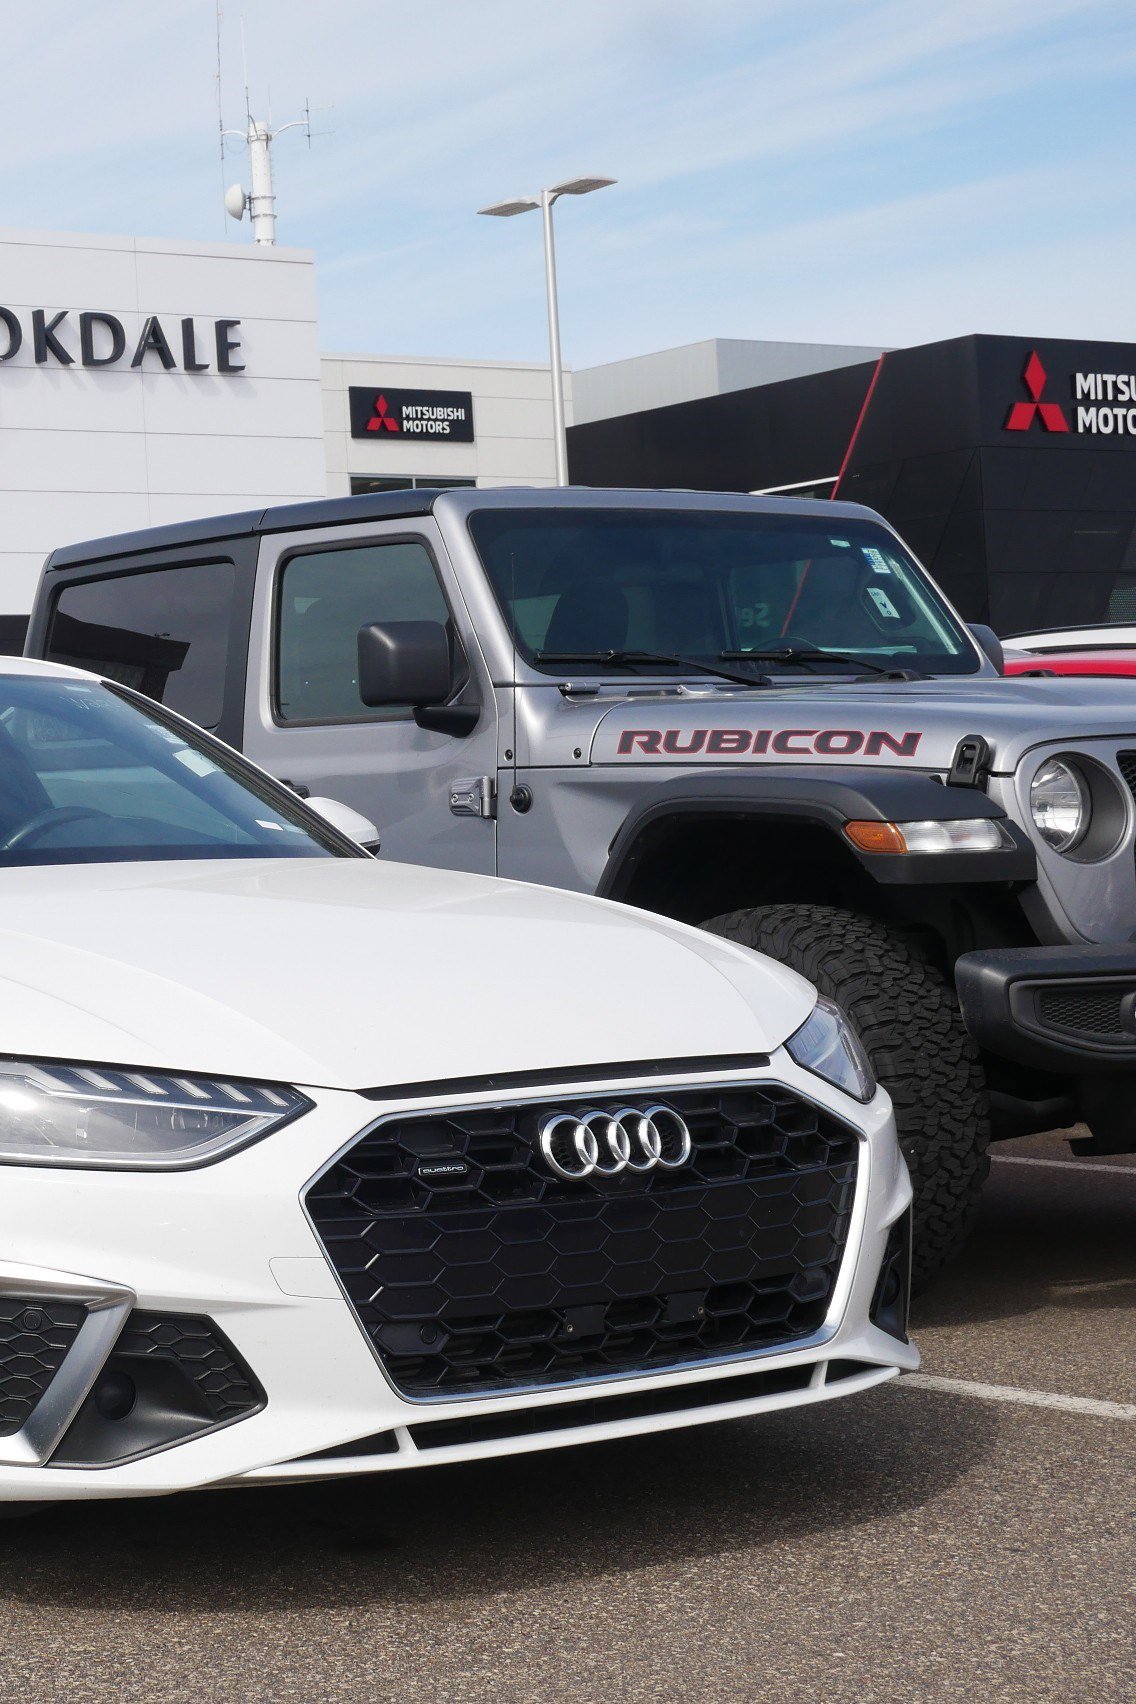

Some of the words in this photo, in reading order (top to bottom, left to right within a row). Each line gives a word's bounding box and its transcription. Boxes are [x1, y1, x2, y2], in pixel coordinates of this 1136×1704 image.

[402, 405, 465, 420] MITSUBISHI
[403, 420, 450, 433] MOTORS
[616, 729, 923, 757] RUBICON
